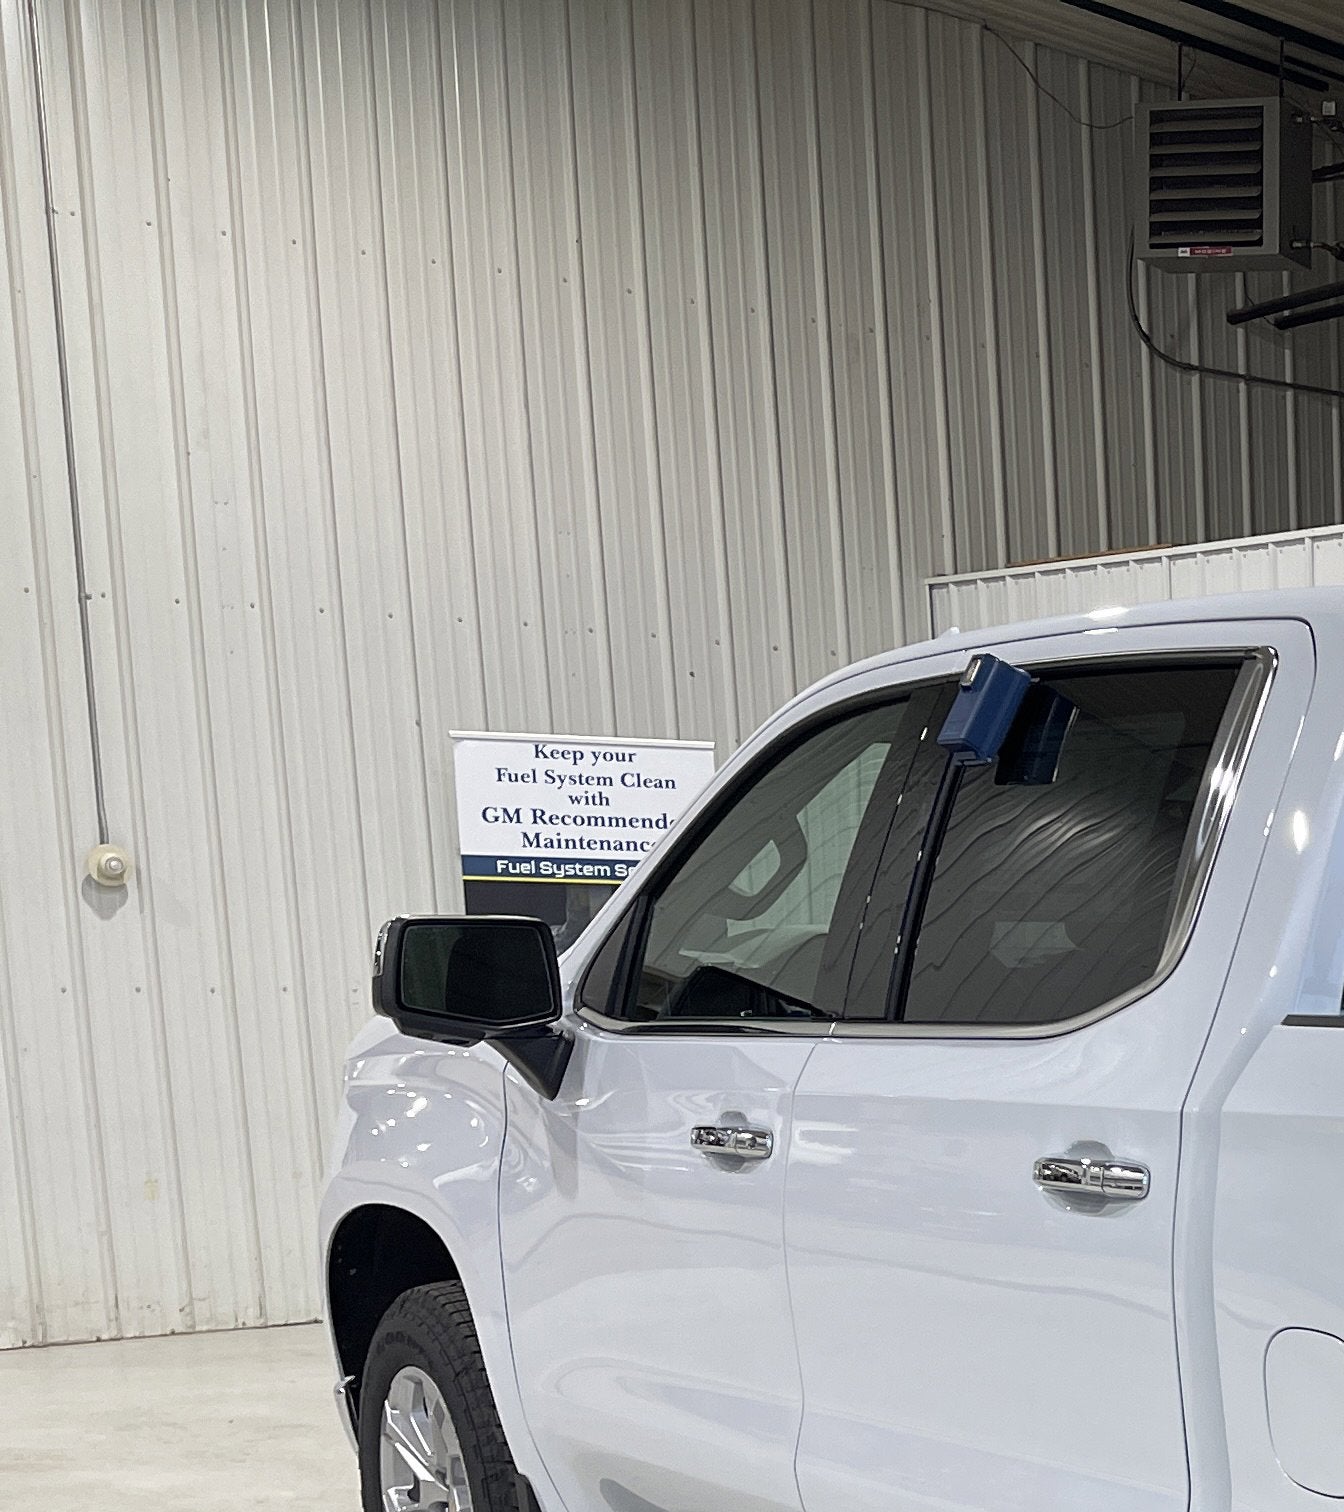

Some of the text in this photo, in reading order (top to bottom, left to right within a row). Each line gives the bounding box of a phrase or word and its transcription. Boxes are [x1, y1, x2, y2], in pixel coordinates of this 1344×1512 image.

[533, 743, 637, 766] Keep your
[496, 767, 677, 790] Fuel System Clean
[568, 791, 611, 807] with
[481, 806, 523, 824] GM
[521, 831, 657, 852] Maintenanc
[496, 859, 536, 875] Fuel
[539, 861, 611, 878] System
